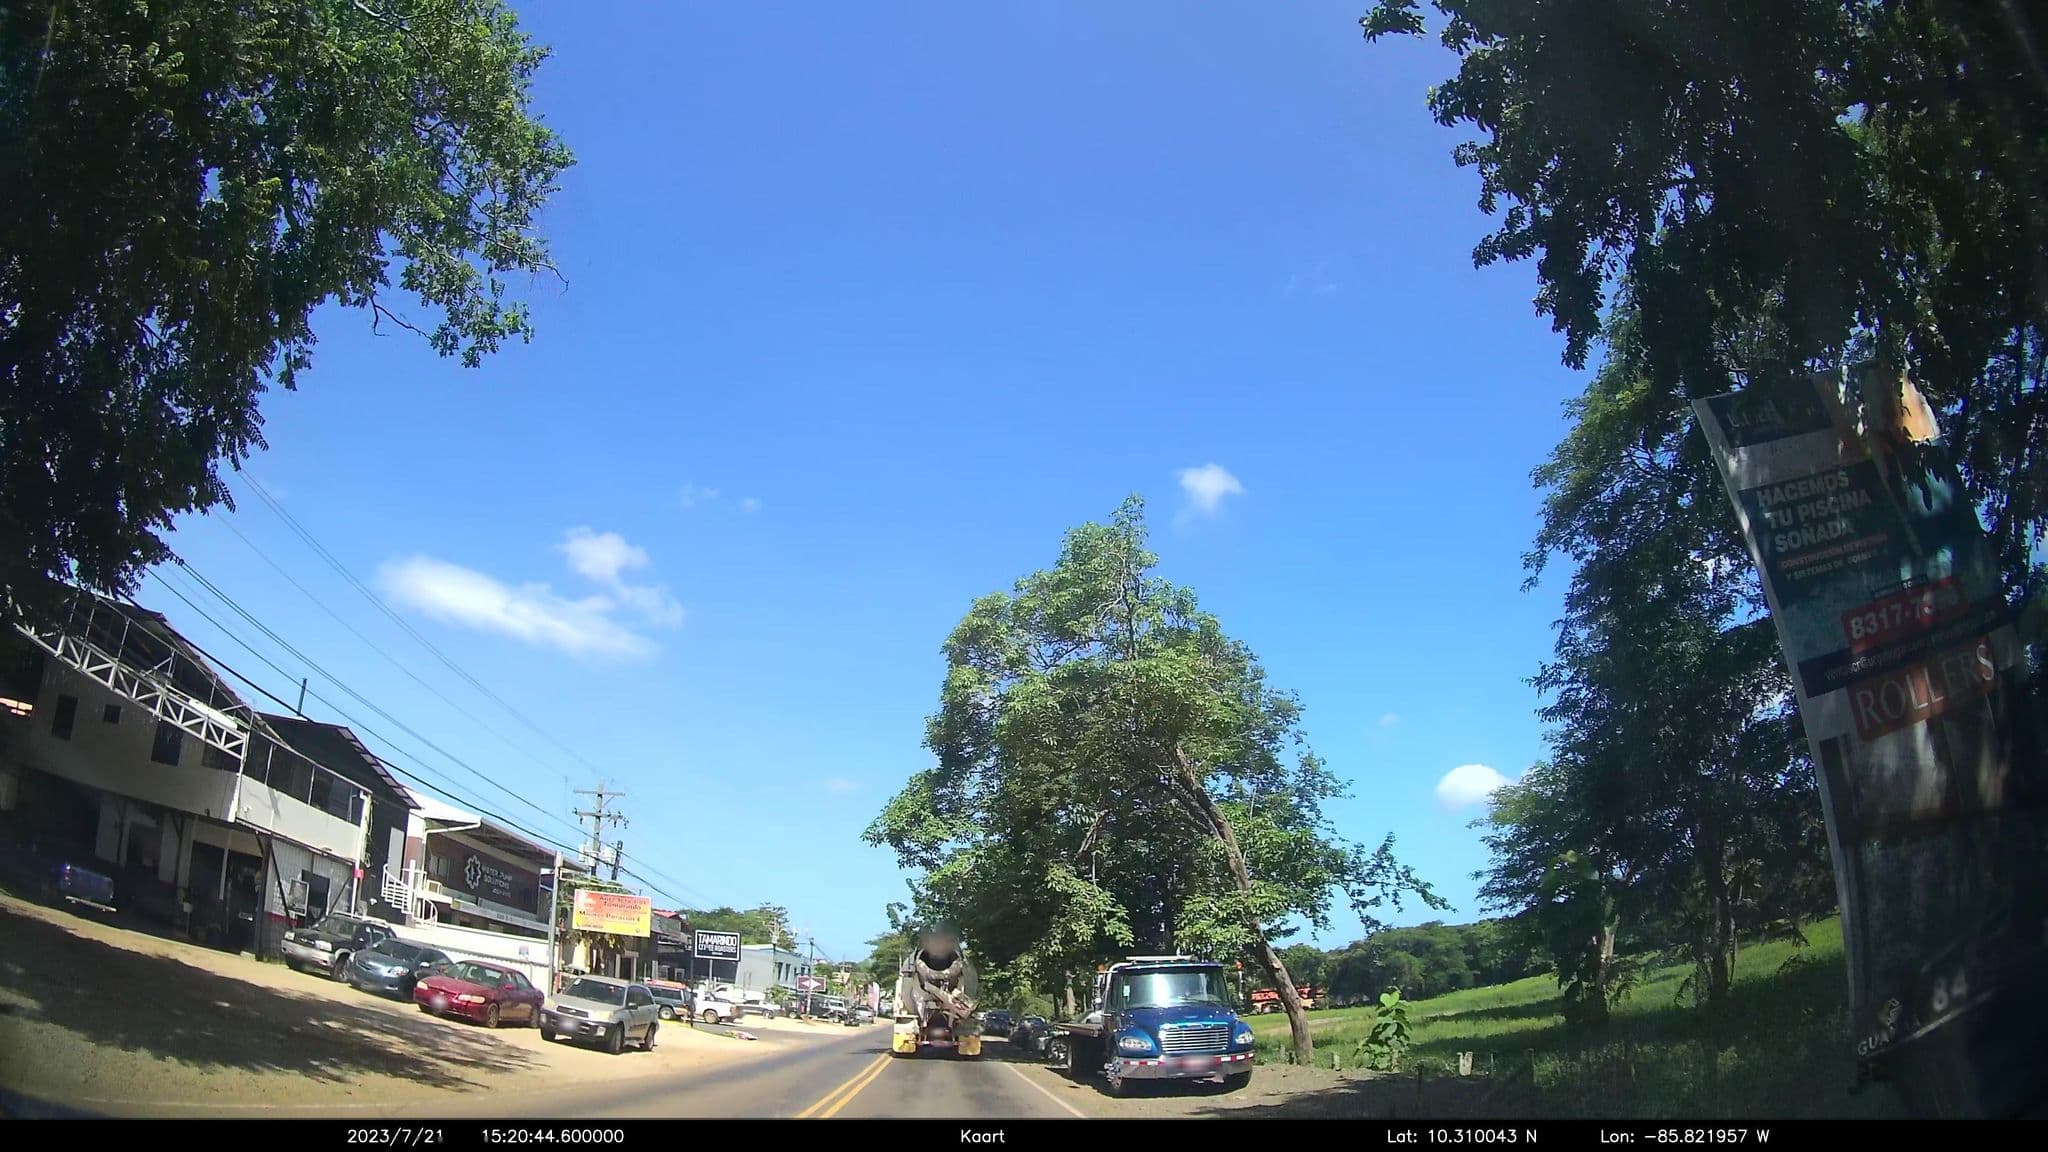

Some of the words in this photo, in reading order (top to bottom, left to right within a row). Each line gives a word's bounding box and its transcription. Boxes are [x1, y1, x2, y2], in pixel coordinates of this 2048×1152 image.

[1756, 470, 1849, 507] HACEMOS
[1764, 507, 1793, 529] TU
[1798, 489, 1873, 523] PISCINA
[1855, 644, 1996, 730] ROLLERS
[698, 933, 737, 947] TAMARINDO
